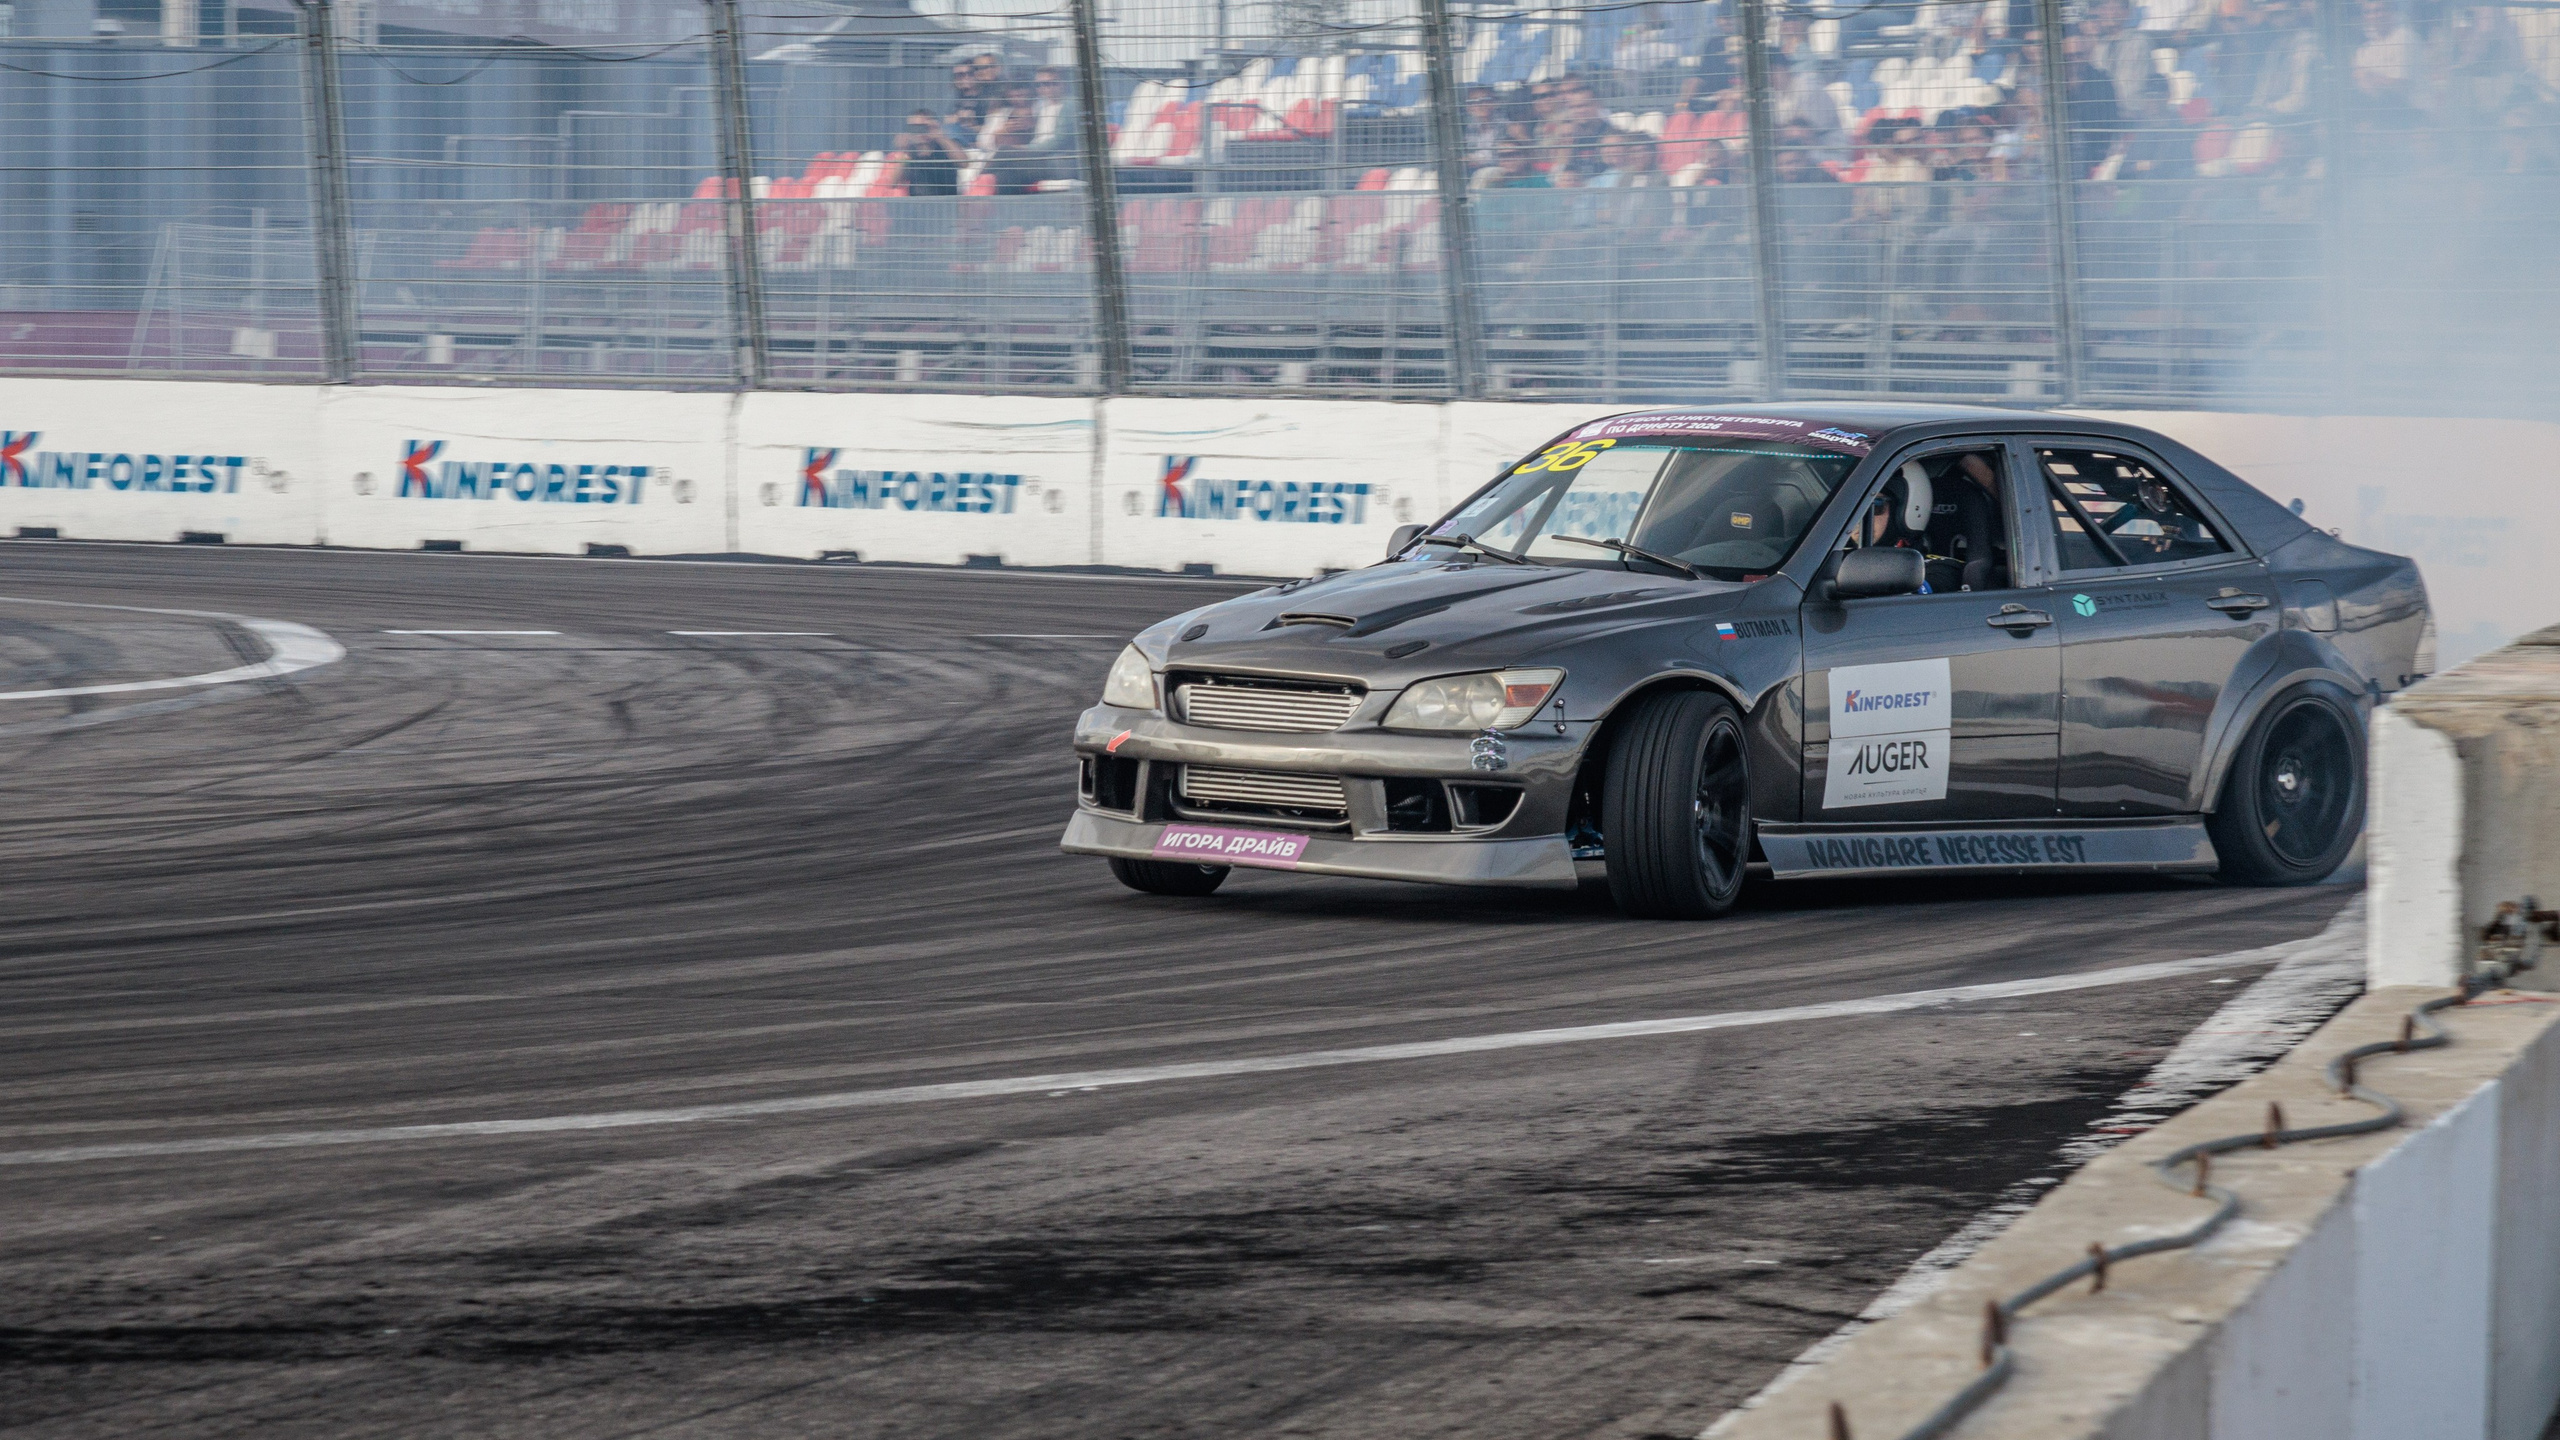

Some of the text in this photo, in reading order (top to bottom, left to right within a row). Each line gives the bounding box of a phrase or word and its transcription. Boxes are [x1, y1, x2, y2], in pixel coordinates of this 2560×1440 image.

[1605, 425, 1624, 434] ПО
[1625, 422, 1684, 434] ДРИФТУ
[1665, 415, 1804, 427] САНКТ-ПЕТЕРБУРГА
[397, 440, 655, 505] KINFOREST
[795, 447, 1026, 514] KINFOREST
[1154, 455, 1375, 525] KINFOREST
[1733, 619, 1793, 639] BUTMAN A
[1844, 689, 1931, 713] KINFOREST
[1847, 741, 1930, 775] AUGER
[1868, 790, 1901, 799] КУЛЬТУРА
[1162, 832, 1298, 857] ИГОРА ДРАЙВ
[1805, 834, 2087, 869] NAVIGARE NECESSE EST
